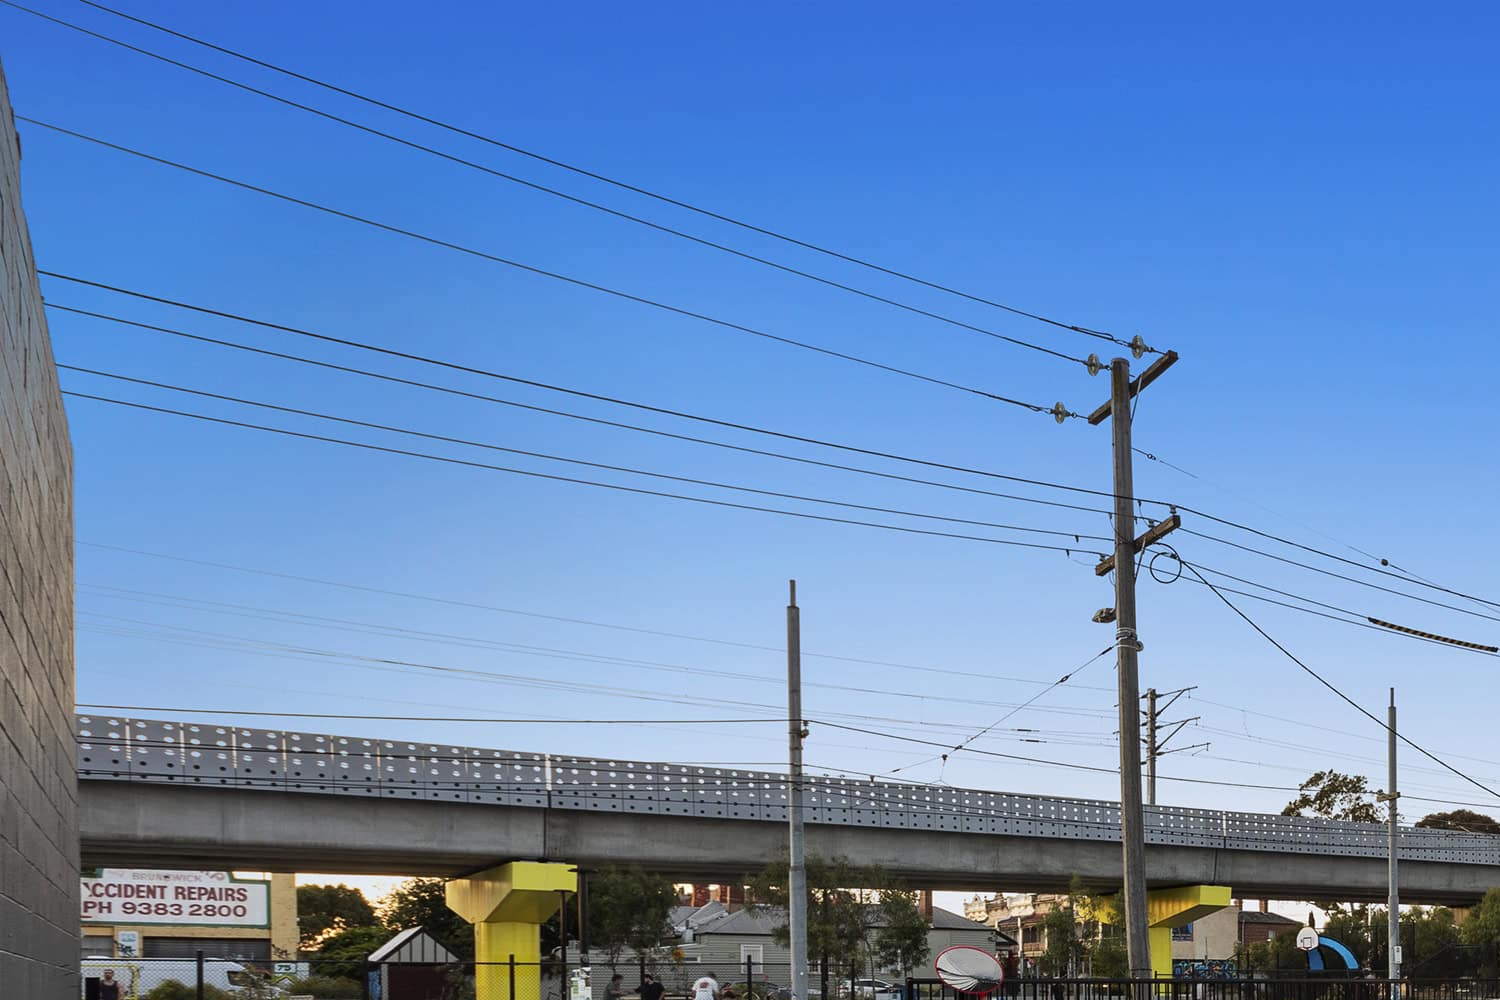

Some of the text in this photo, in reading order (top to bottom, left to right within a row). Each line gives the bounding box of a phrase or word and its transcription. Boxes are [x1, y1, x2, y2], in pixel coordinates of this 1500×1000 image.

[174, 886, 248, 902] REPAIRS
[83, 901, 247, 918] PH 9383 2800
